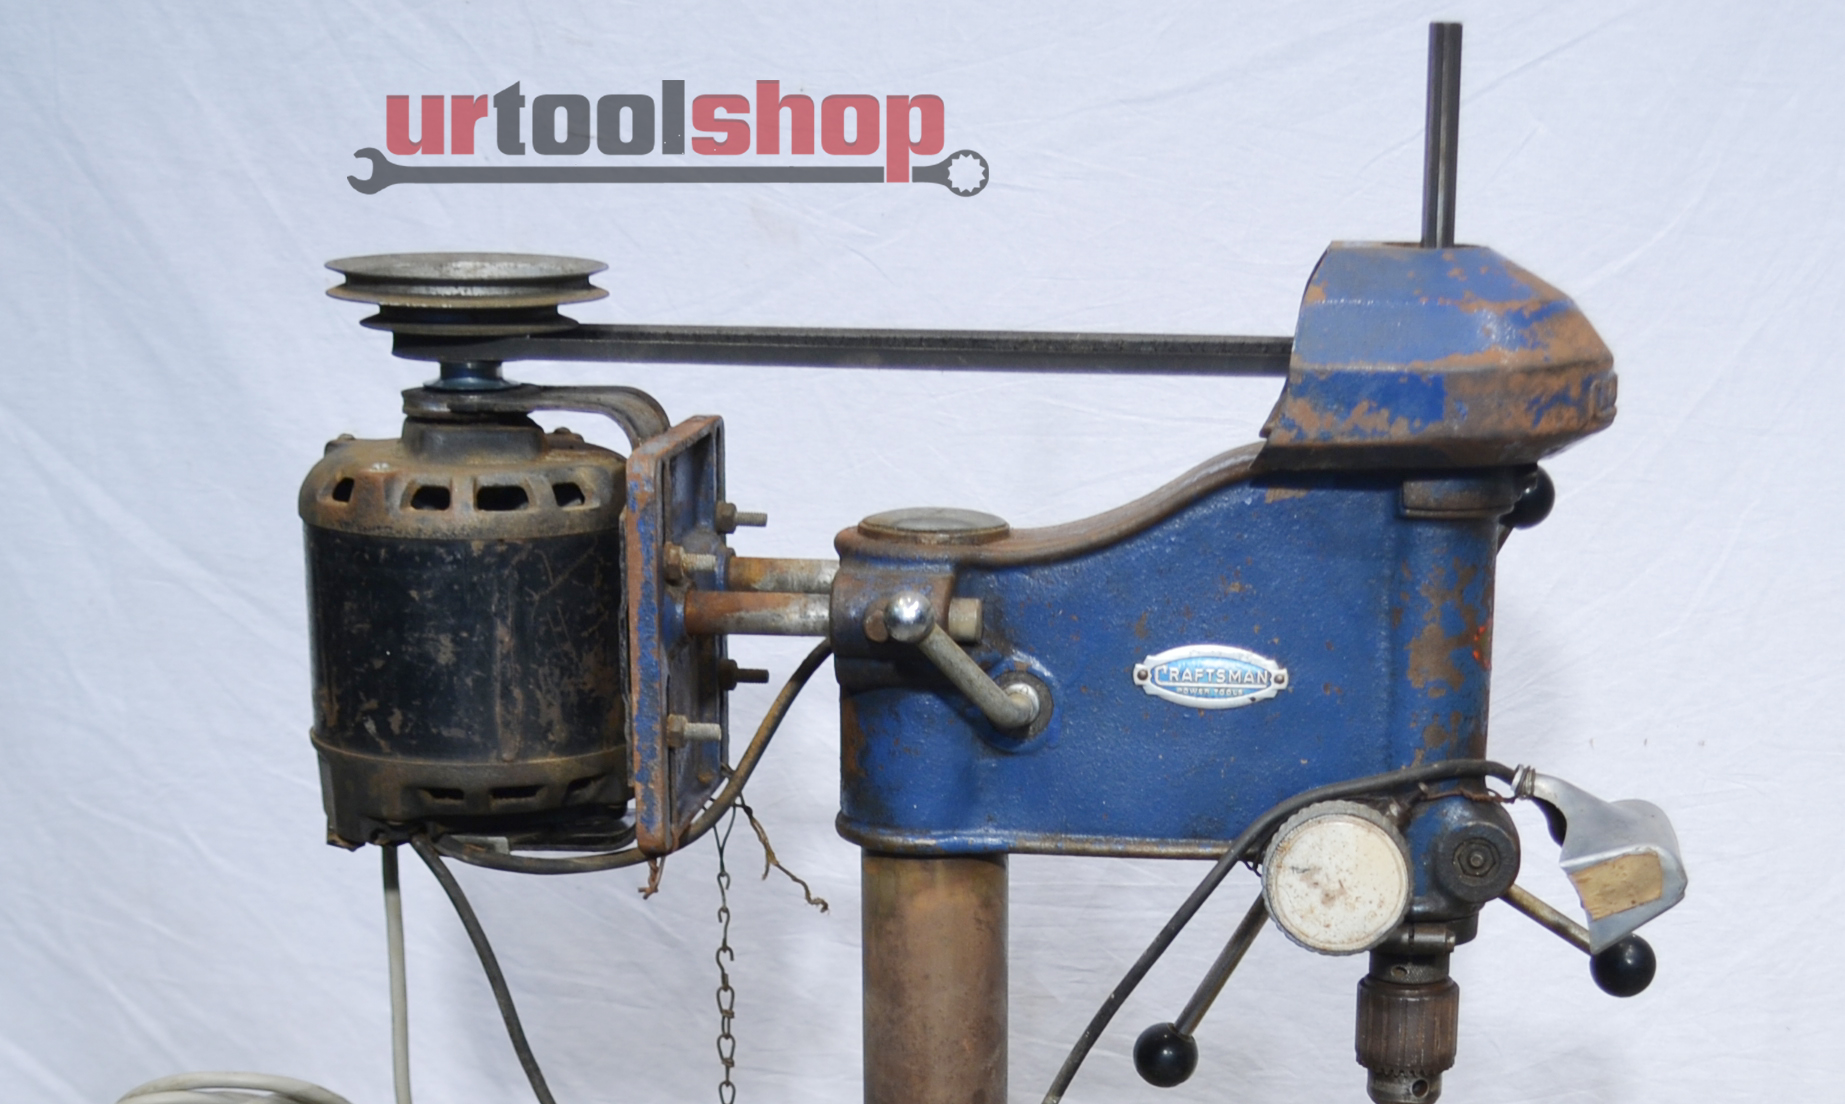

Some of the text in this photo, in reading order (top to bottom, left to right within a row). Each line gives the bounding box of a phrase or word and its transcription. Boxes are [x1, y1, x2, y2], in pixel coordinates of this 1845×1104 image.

[1154, 664, 1268, 685] CRAFTSMAN
[1176, 687, 1244, 696] POWER TOOLS
